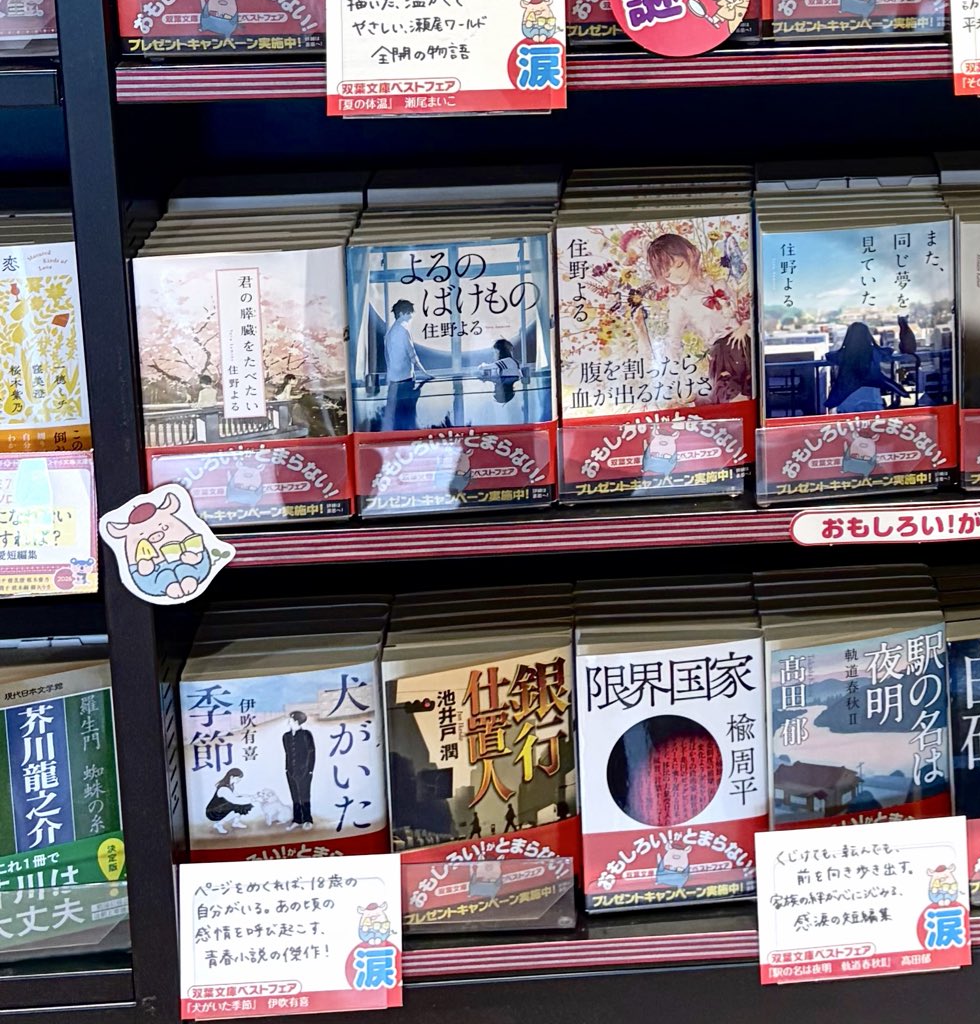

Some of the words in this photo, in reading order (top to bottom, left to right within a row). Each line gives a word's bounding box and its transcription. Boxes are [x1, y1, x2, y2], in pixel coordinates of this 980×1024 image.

[128, 36, 301, 54] プレゼントキャンペーン実施中!
[370, 42, 472, 66] 全開の物語
[516, 45, 562, 90] 涙
[341, 80, 456, 95] 双葉文庫ベストフェア
[404, 95, 457, 109] 瀬尾まいこ
[399, 251, 488, 286] よるの
[860, 235, 878, 308] 見ていた
[892, 232, 912, 310] 同じ夢を
[924, 229, 946, 273] また、
[567, 237, 591, 323] 住野よる
[779, 242, 797, 310] 住野よる
[421, 281, 541, 319] ばけもの
[237, 275, 260, 412] 君の膵臓をたべたい
[421, 320, 484, 341] 住野よる
[227, 365, 241, 413] 住野よる
[579, 354, 699, 384] 腹を割ったら
[570, 376, 714, 410] 血が出るだけさ
[585, 650, 759, 713] 限界国家
[863, 642, 906, 727] 夜明
[79, 695, 102, 751] 羅生門
[187, 684, 235, 773] 季節
[238, 697, 259, 763] 伊吹有喜
[436, 690, 460, 762] 池井戸潤
[507, 655, 571, 784] 銀行
[904, 631, 946, 787] 駅の名は
[324, 672, 372, 833] 犬がいた
[460, 666, 517, 809] 仕置人
[724, 712, 760, 807] 楡周平
[17, 704, 63, 850] 芥川龍之介
[82, 764, 107, 834] 蜘蛛の糸
[106, 843, 119, 874] 決定版
[796, 861, 914, 886] 前を向き歩き出す。
[793, 907, 894, 932] 感涙の短編集
[926, 908, 966, 950] 涙
[204, 944, 330, 969] 青春小説の傑作!
[353, 948, 397, 990] 涙
[770, 944, 872, 963] 双葉文庫ベストフェア
[191, 982, 298, 998] 双葉文庫ベストフェア
[267, 996, 311, 1009] 伊吹有喜
